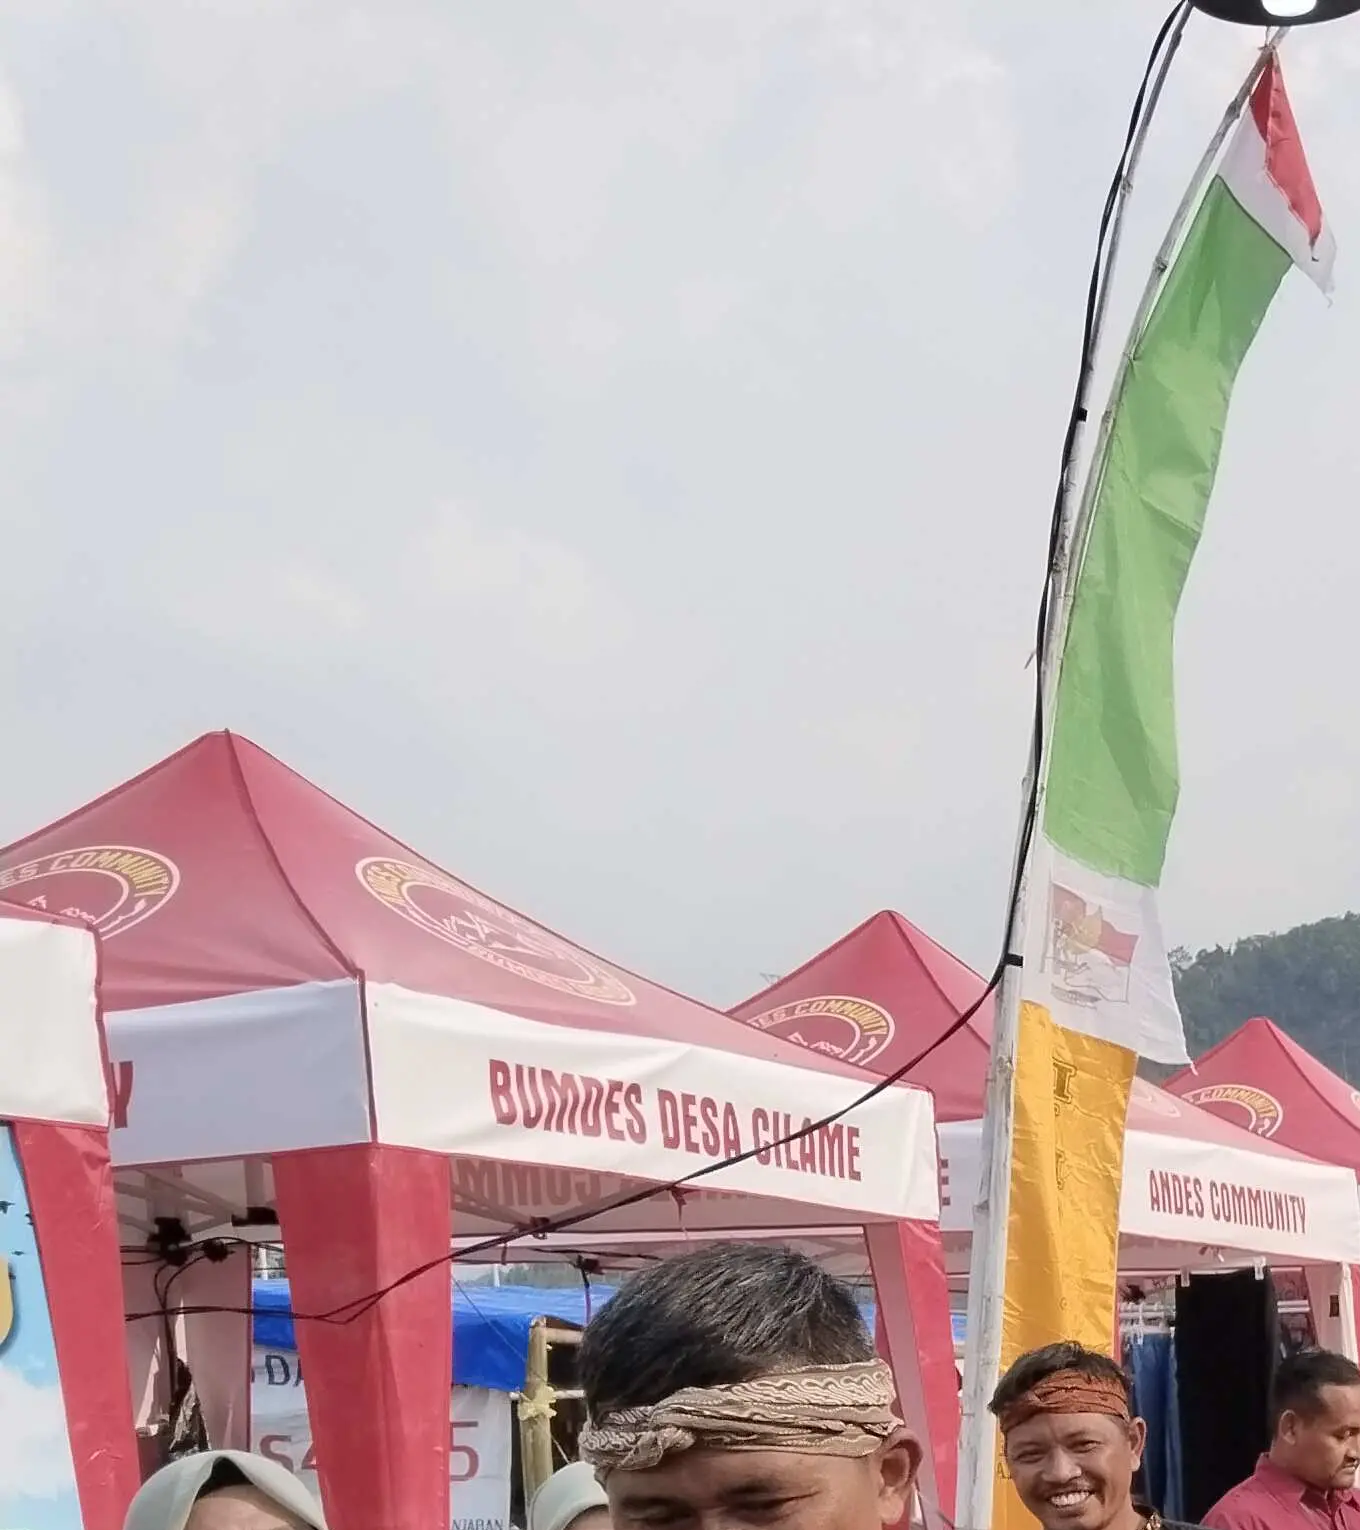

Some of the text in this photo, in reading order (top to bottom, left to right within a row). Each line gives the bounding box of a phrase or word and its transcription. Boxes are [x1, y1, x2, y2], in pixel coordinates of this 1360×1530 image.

[488, 1058, 647, 1145] BUMDES
[656, 1087, 742, 1161] DESA
[751, 1107, 862, 1182] CILAME
[1149, 1169, 1307, 1235] ANDES COMMUNITY
